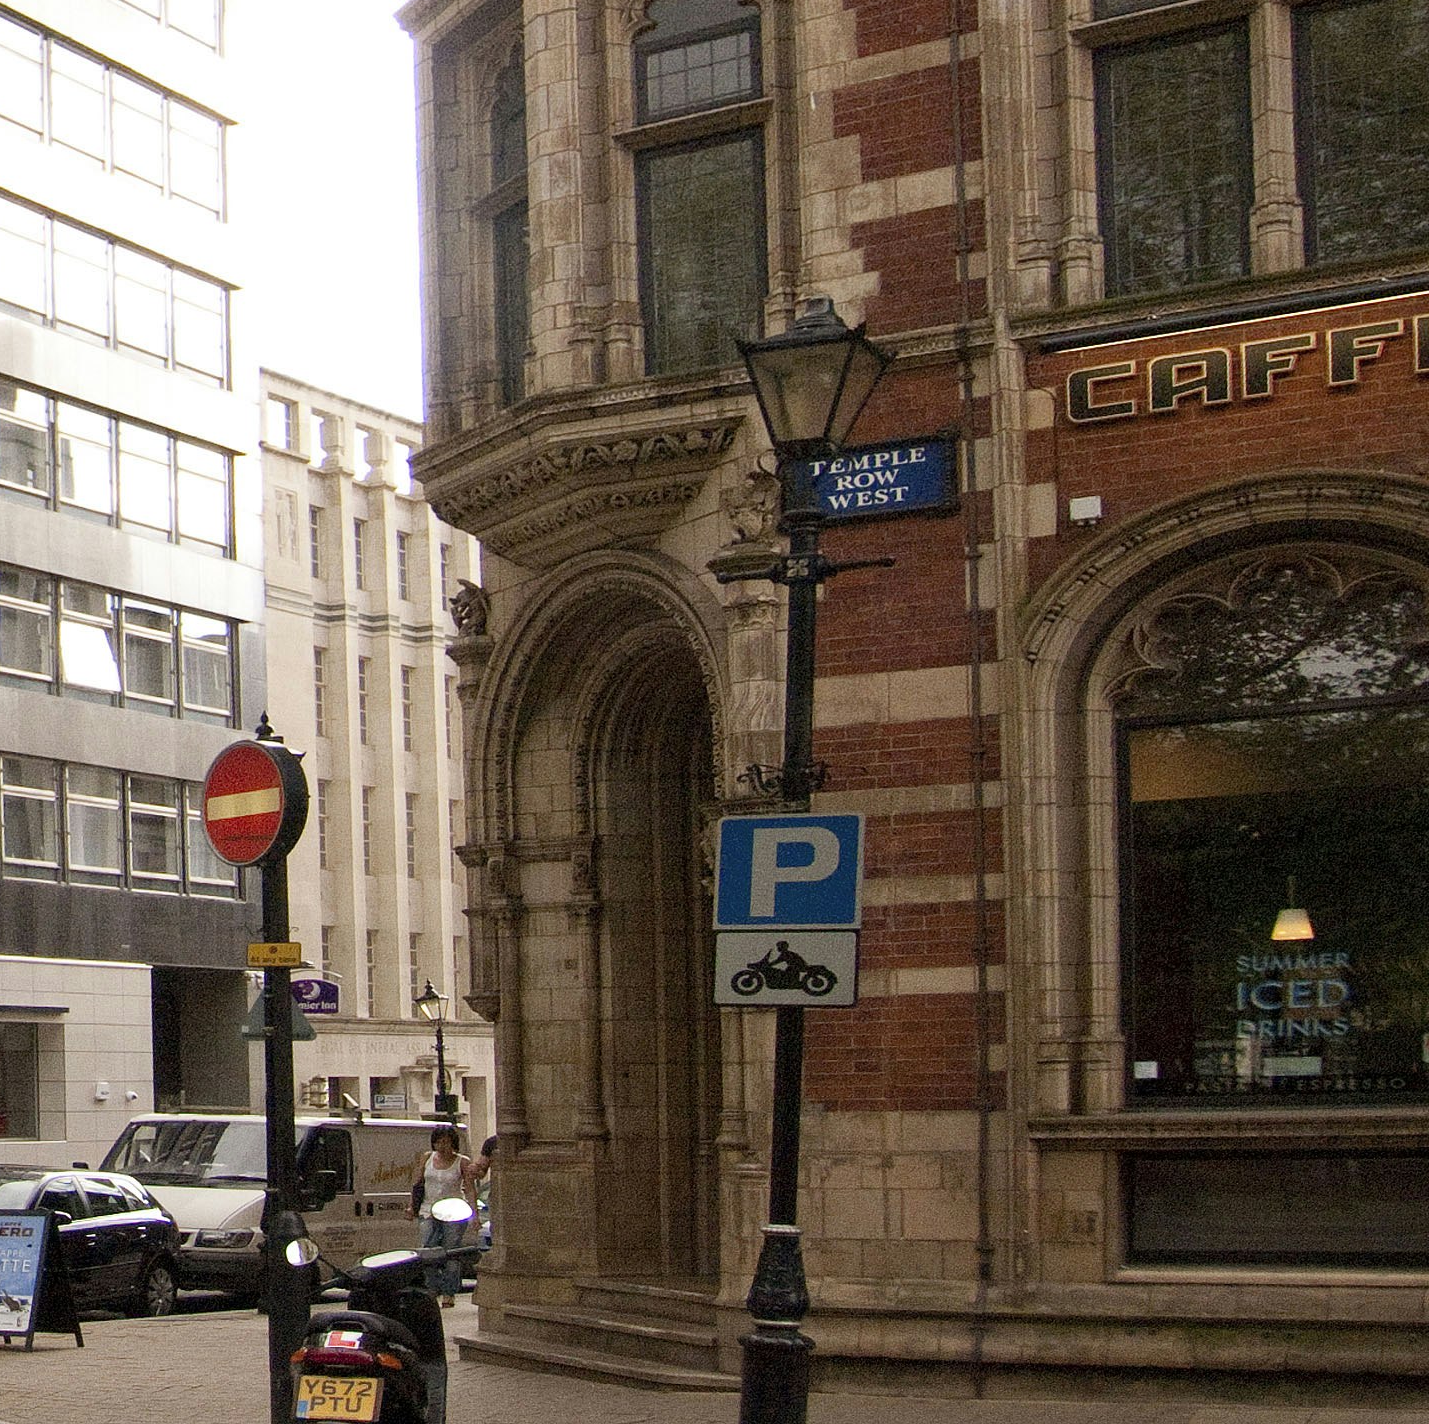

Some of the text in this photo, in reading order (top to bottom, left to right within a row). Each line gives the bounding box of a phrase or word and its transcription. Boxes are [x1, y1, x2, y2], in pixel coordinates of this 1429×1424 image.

[1067, 314, 1429, 424] CAFF
[809, 447, 926, 476] TEMPLE
[835, 469, 899, 491] ROW
[827, 486, 909, 510] WEST
[749, 826, 841, 917] P
[1237, 951, 1351, 972] SUMMER
[1236, 978, 1351, 1011] ICED
[1236, 1017, 1351, 1039] DRINKS
[328, 1331, 356, 1347] L
[305, 1379, 372, 1396] Y672
[309, 1396, 362, 1413] PTU
